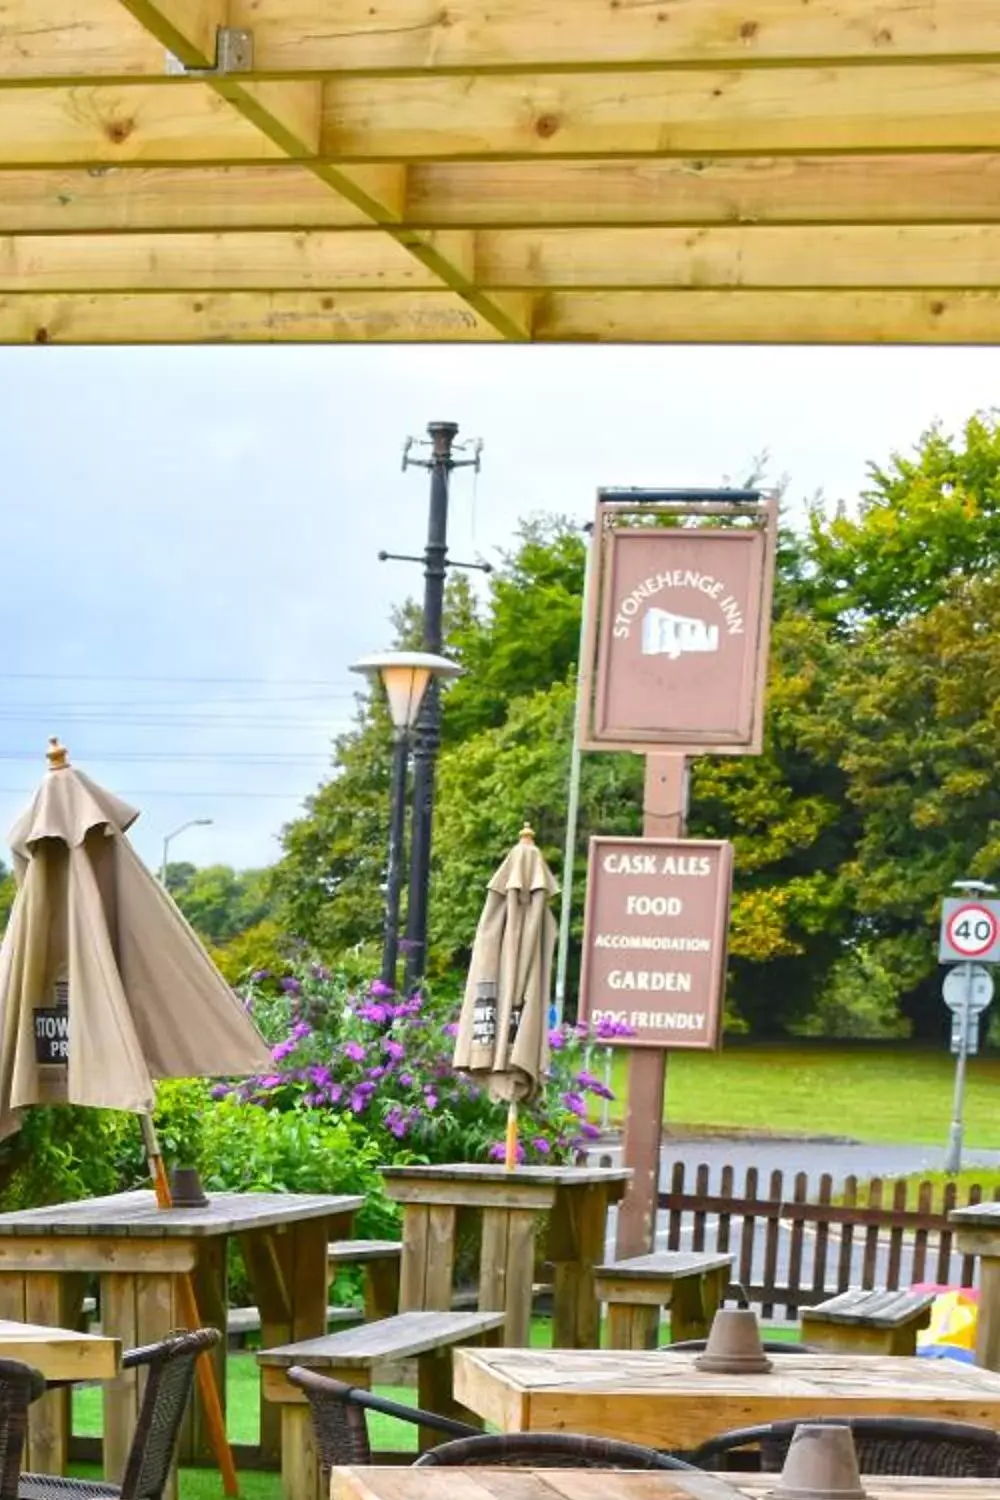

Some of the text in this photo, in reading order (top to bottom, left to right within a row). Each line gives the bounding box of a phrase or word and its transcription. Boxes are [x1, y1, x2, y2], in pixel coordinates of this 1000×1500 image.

[613, 570, 744, 638] STONEHENGE INN
[603, 854, 711, 876] CASK ALES
[626, 895, 683, 916] FOOD
[955, 920, 991, 940] 40
[594, 935, 711, 951] ACCOMMODATION
[607, 970, 691, 992] GARDEN
[629, 1010, 706, 1030] FRIENDLY
